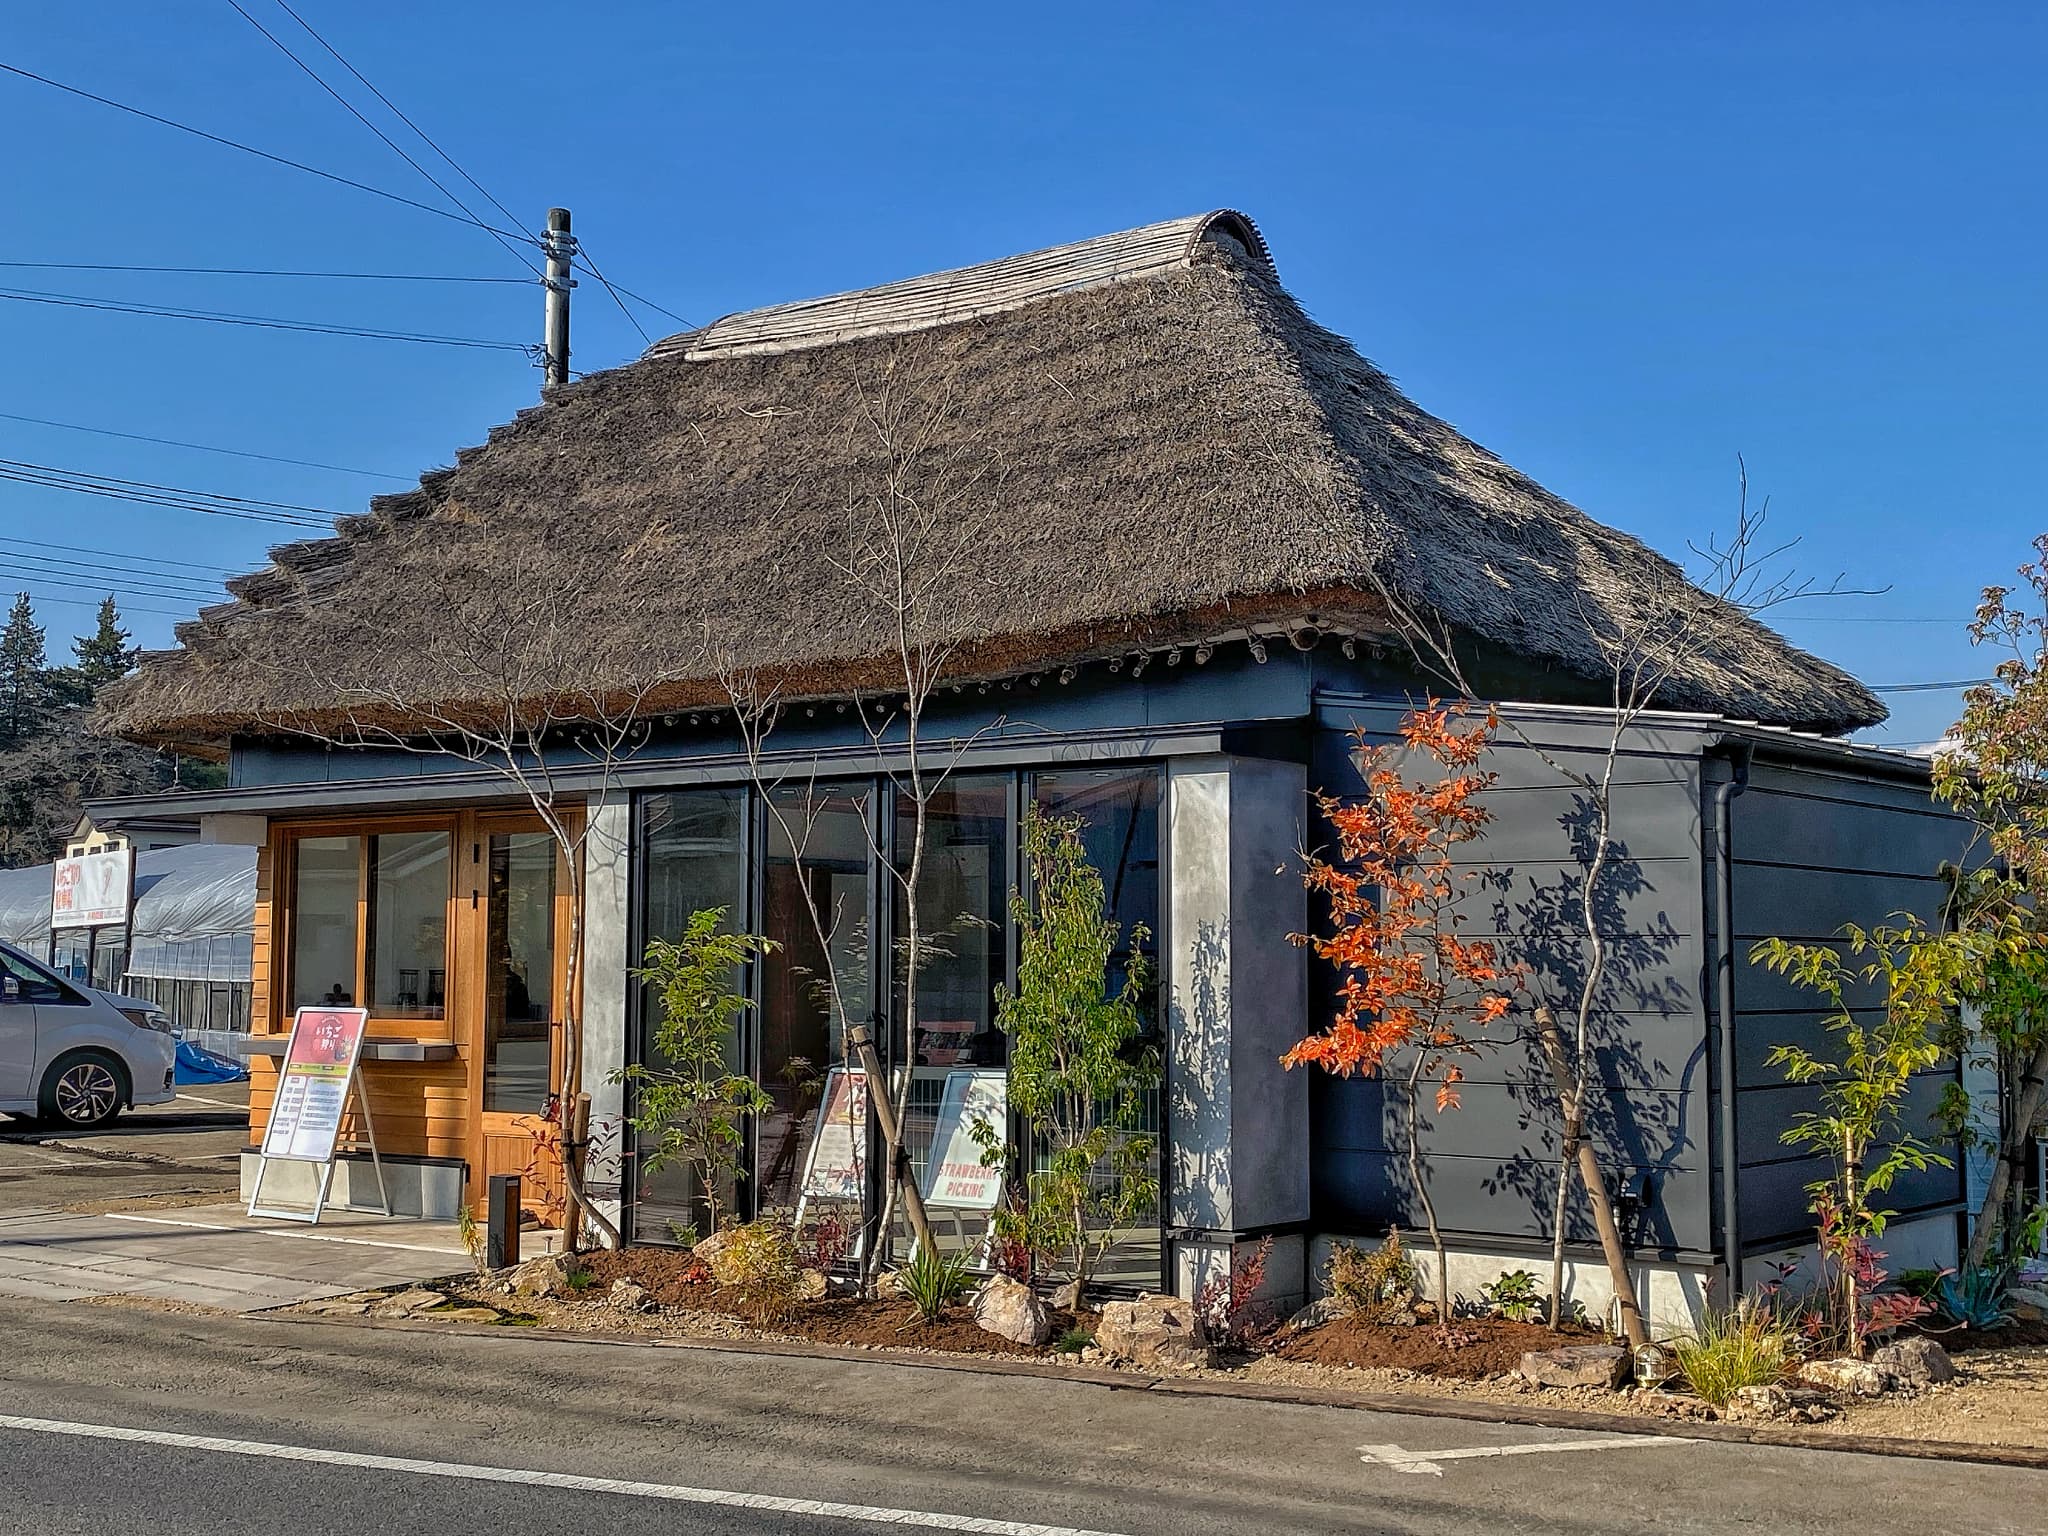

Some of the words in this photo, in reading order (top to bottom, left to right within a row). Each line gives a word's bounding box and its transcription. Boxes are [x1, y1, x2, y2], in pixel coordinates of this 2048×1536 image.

[316, 1023, 343, 1038] いちご
[945, 1182, 985, 1198] PICKING
